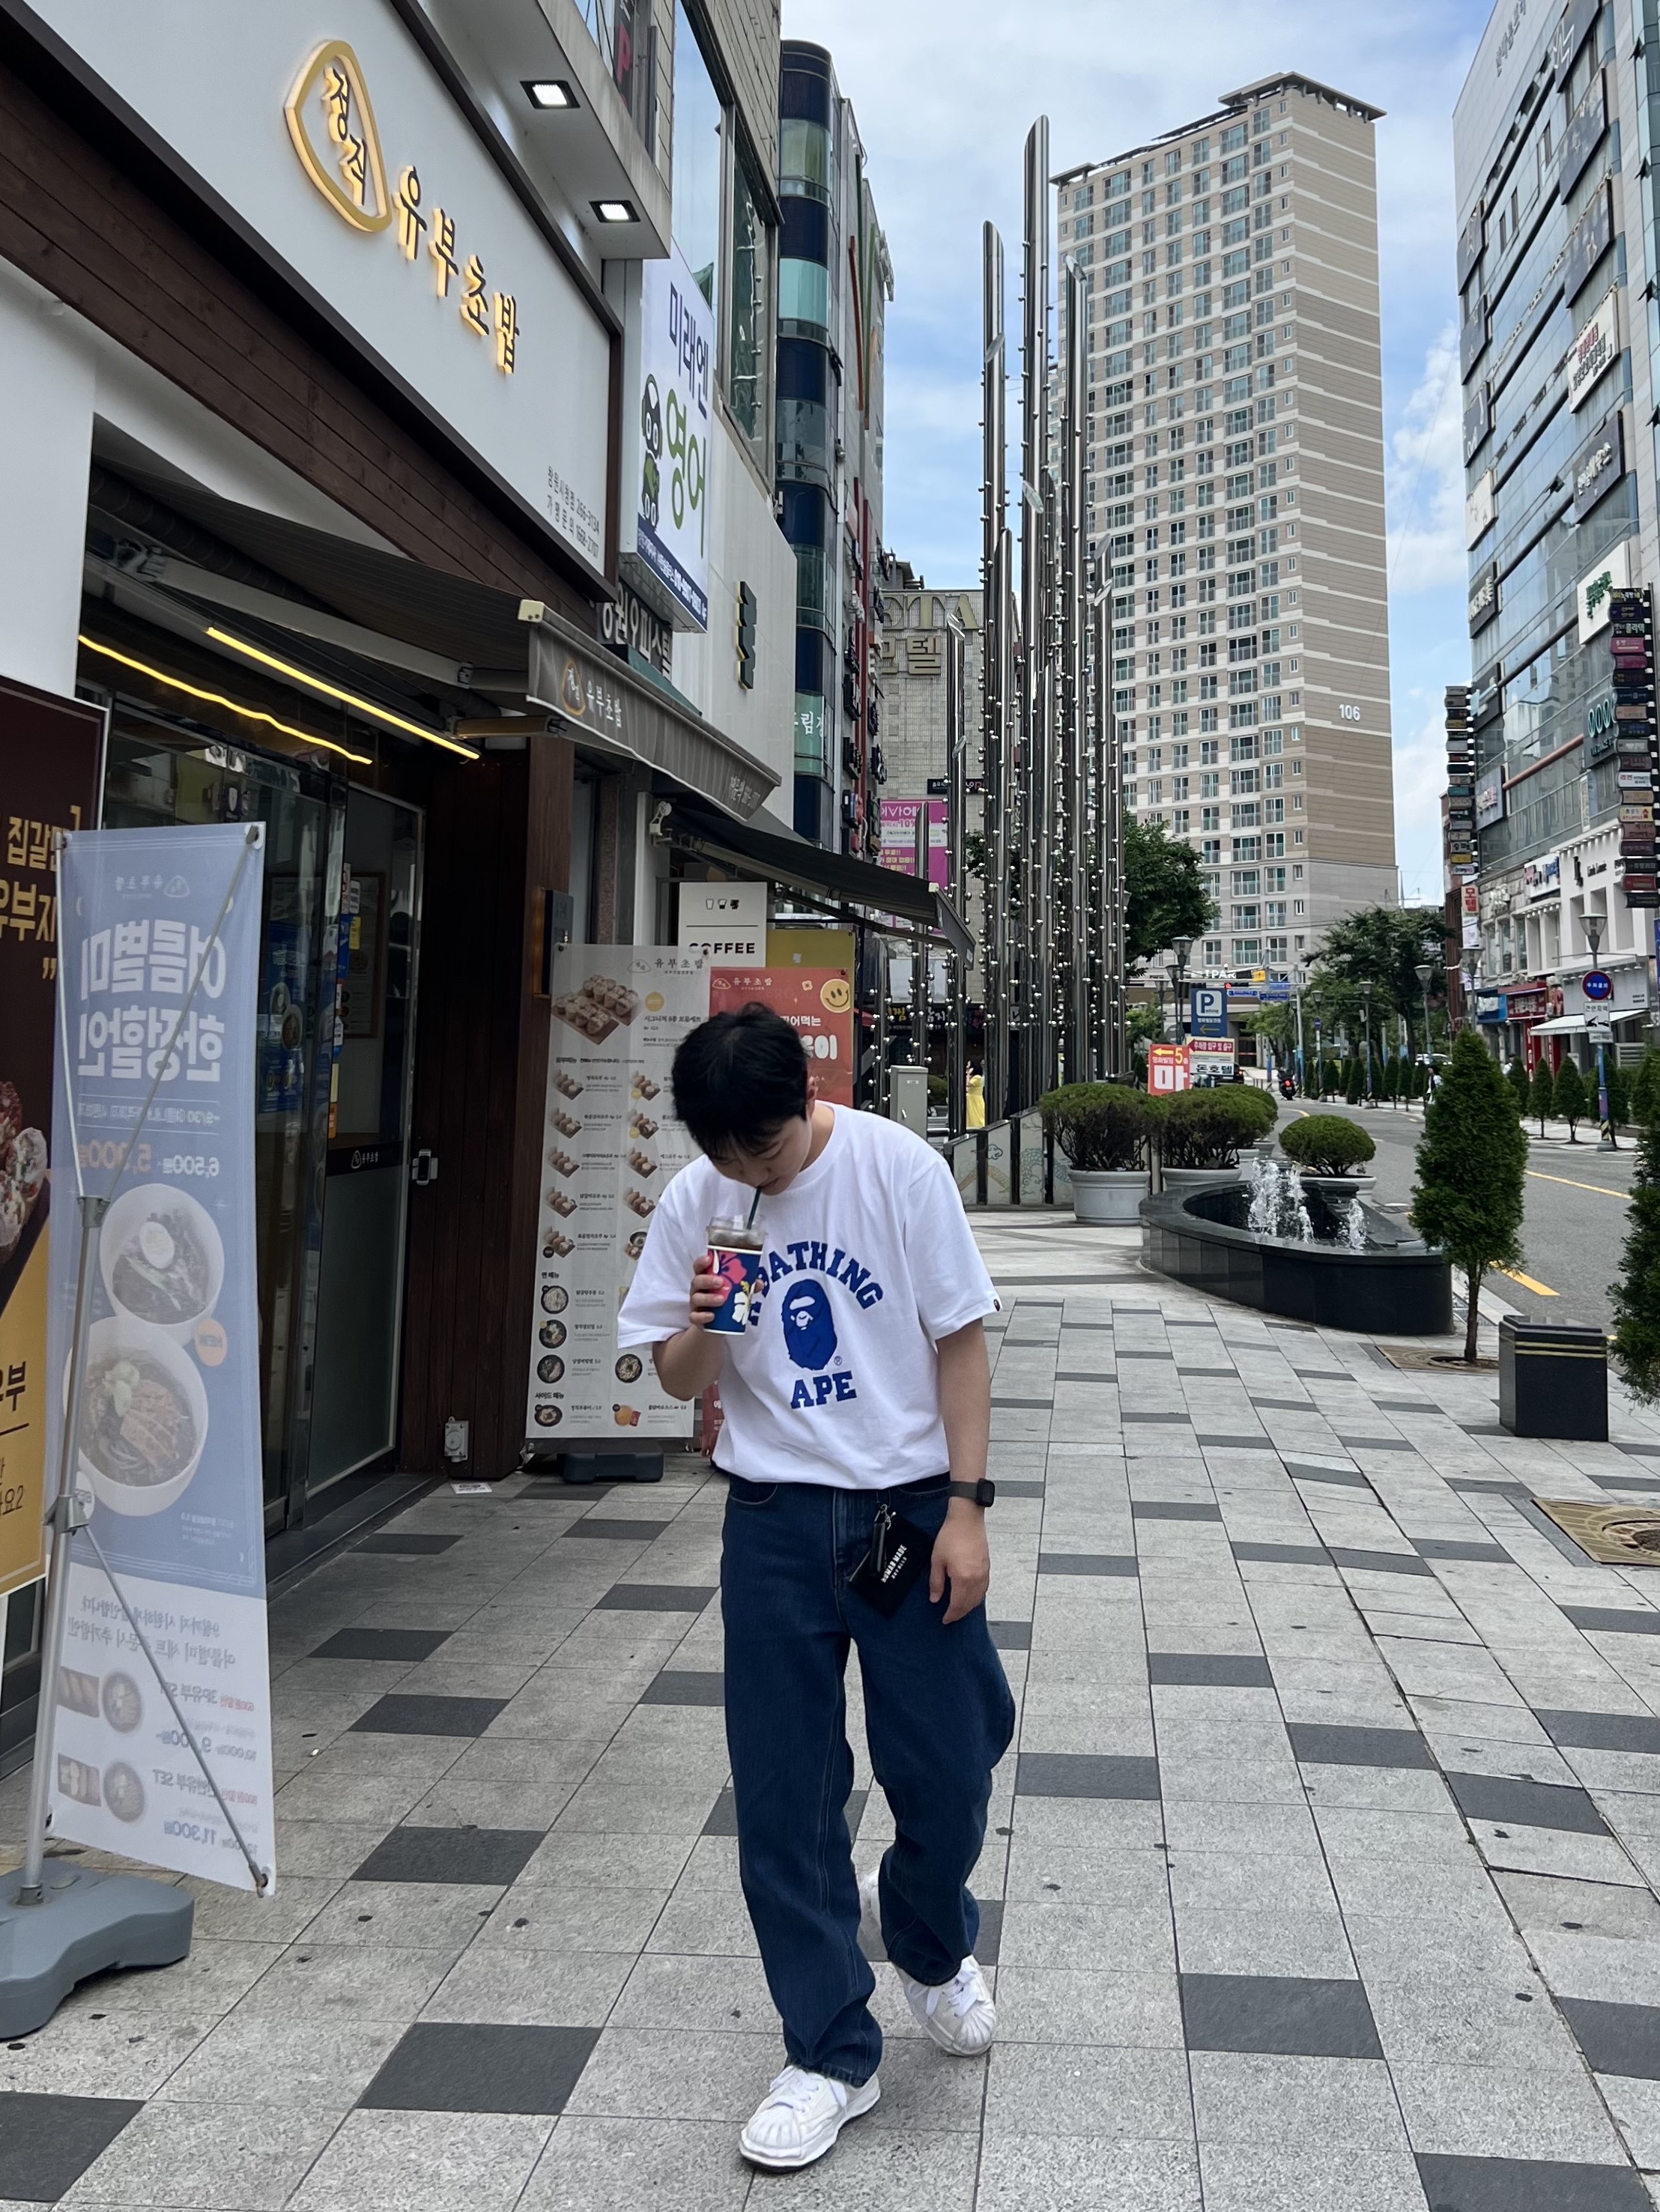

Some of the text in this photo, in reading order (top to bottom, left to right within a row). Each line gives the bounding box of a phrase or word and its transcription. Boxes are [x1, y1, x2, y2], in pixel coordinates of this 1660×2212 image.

[321, 66, 521, 375] 정직 유부초밥
[670, 281, 709, 420] 미래엔
[666, 388, 707, 559] 영어
[587, 680, 622, 728] 유부초밥
[1339, 703, 1360, 721] 106
[1464, 887, 1477, 912] 모텔
[655, 957, 704, 970] 유부초밥
[733, 977, 773, 987] 유부초밥
[790, 1370, 857, 1410] APE
[892, 1545, 907, 1563] MADE
